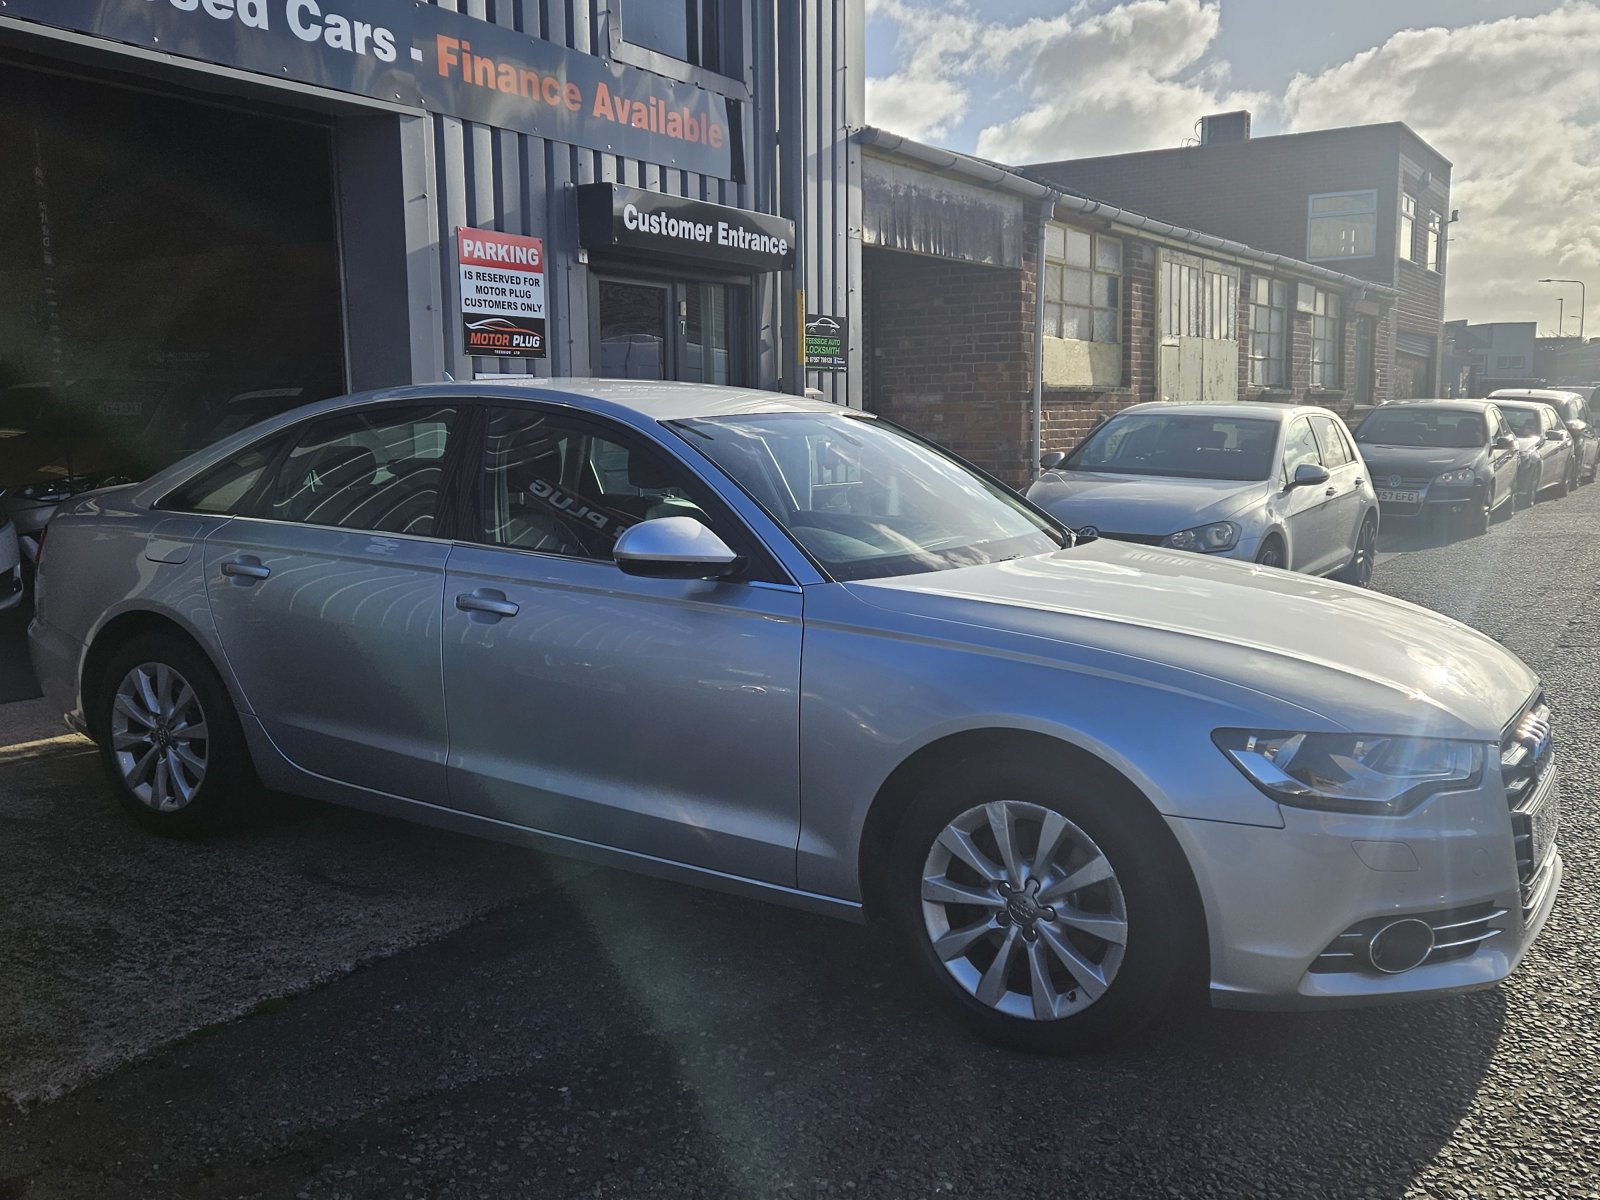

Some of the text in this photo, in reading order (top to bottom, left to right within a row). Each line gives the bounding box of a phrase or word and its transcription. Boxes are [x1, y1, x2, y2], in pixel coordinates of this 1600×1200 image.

[286, 0, 396, 62] Cars
[436, 34, 582, 111] Finance
[593, 82, 724, 148] Available
[623, 203, 788, 256] Customer Entrance
[463, 239, 539, 265] PARKING
[464, 270, 541, 288] IS RESERVED FOR
[475, 285, 532, 299] MOTOR PLUG
[464, 297, 543, 313] CUSTOMERS ONLY
[470, 332, 540, 348] MOTOR PLUG
[806, 346, 840, 354] LOCKSMITH
[1395, 492, 1414, 502] EFG
